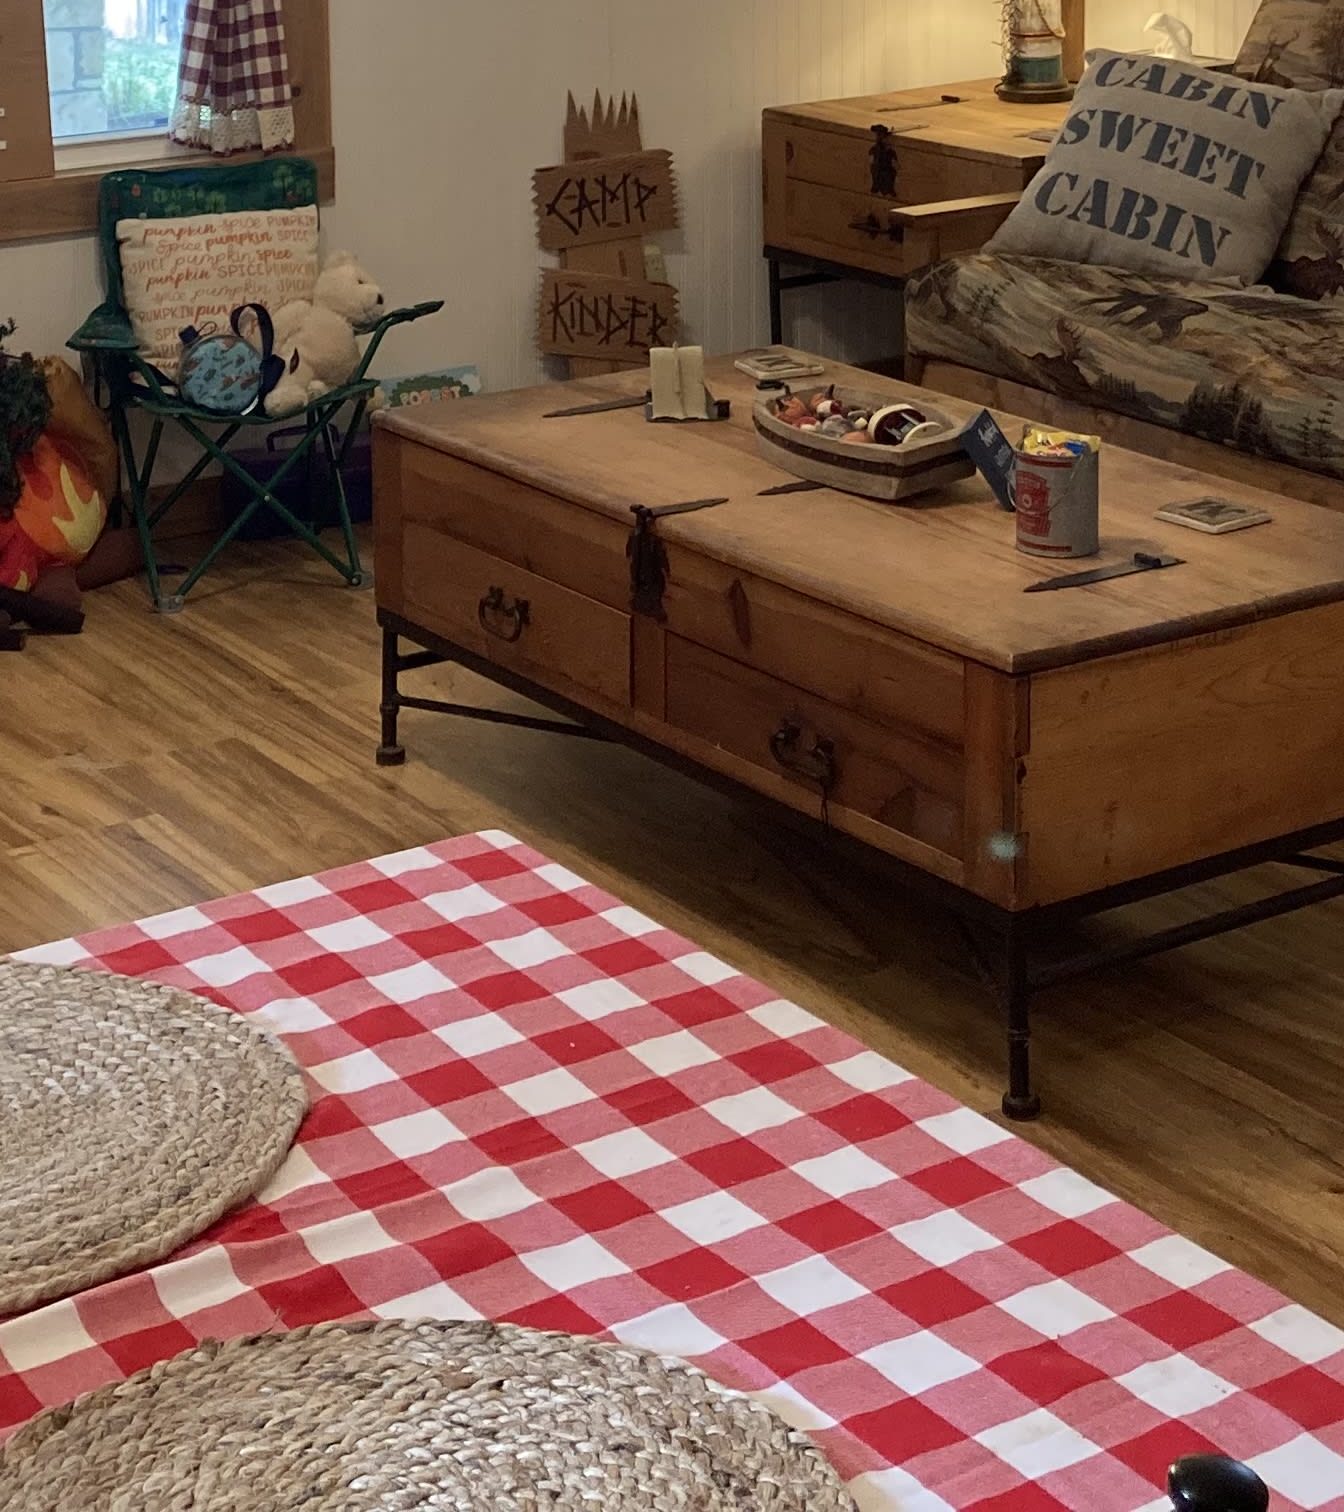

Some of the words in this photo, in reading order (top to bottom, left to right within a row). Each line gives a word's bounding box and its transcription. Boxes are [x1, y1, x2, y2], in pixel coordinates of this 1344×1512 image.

[1094, 56, 1285, 130] CABIN
[1055, 108, 1266, 200] SWEET
[143, 223, 216, 244] pumpkin
[266, 214, 316, 227] PUMPKIN
[546, 171, 658, 236] CAMP
[1034, 170, 1233, 267] CABIN
[174, 245, 255, 269] pumpkin
[206, 230, 272, 251] pumpkin
[145, 268, 210, 292] pumpkin
[217, 263, 265, 278] SPICE
[546, 282, 669, 349] KINDER
